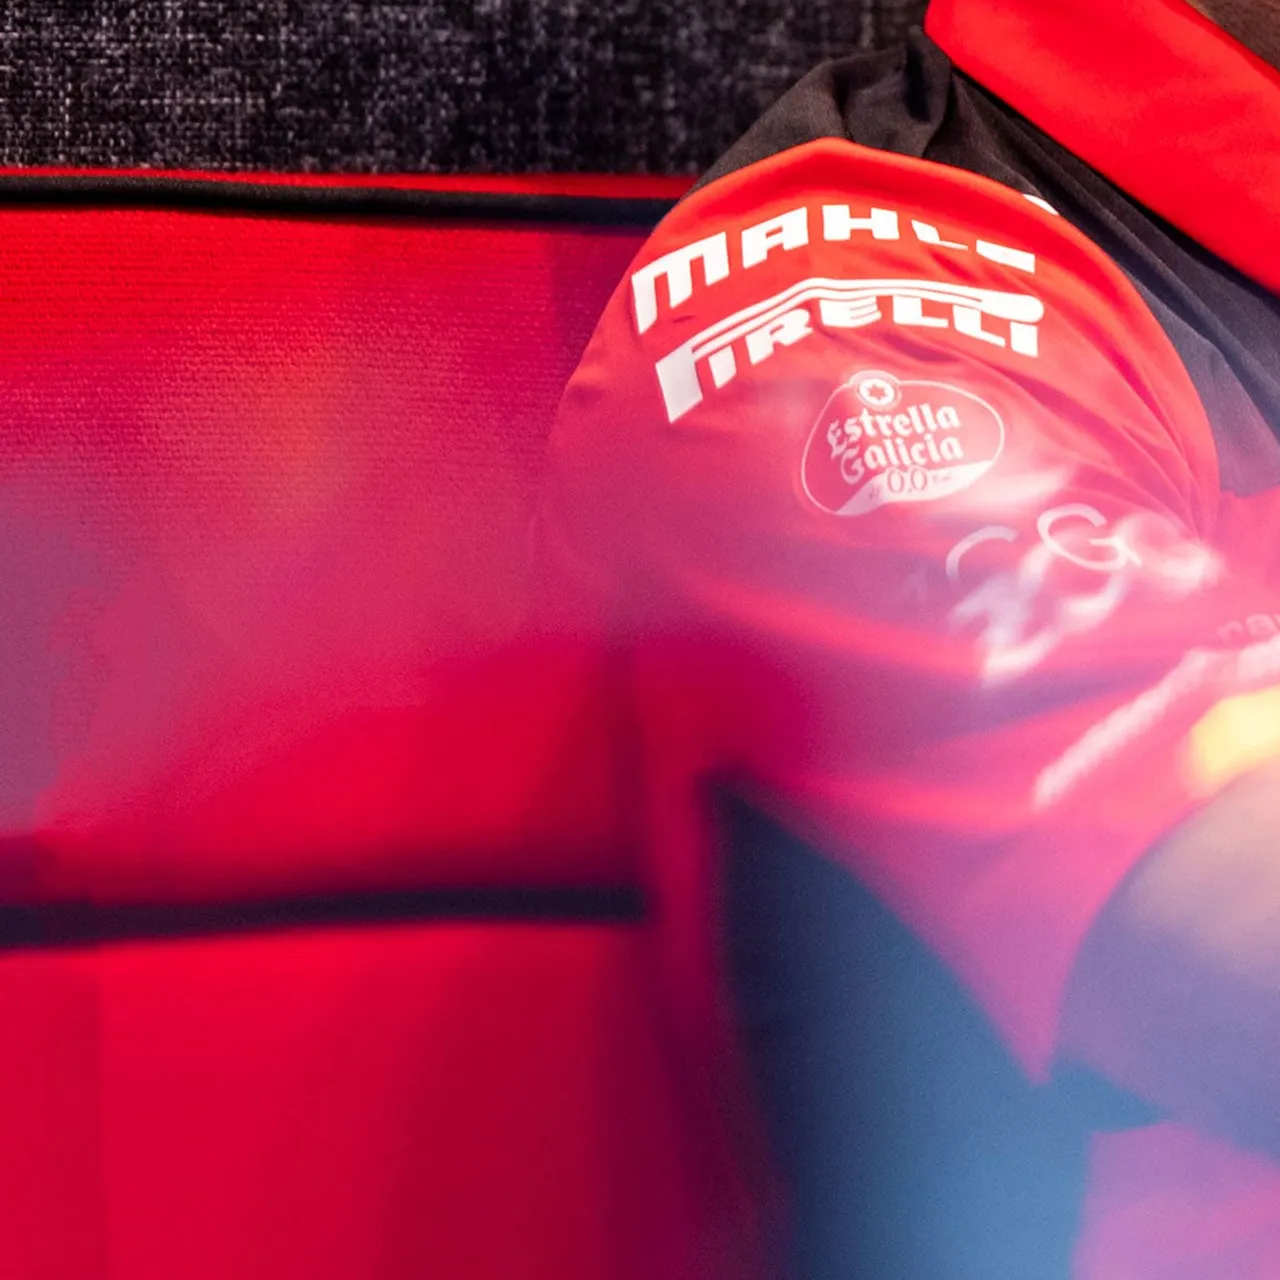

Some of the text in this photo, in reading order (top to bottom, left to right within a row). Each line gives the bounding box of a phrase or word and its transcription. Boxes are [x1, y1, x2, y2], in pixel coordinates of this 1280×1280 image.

[655, 277, 1045, 424] PIRELLI
[826, 403, 961, 461] Estrella
[840, 433, 965, 486] Galicia
